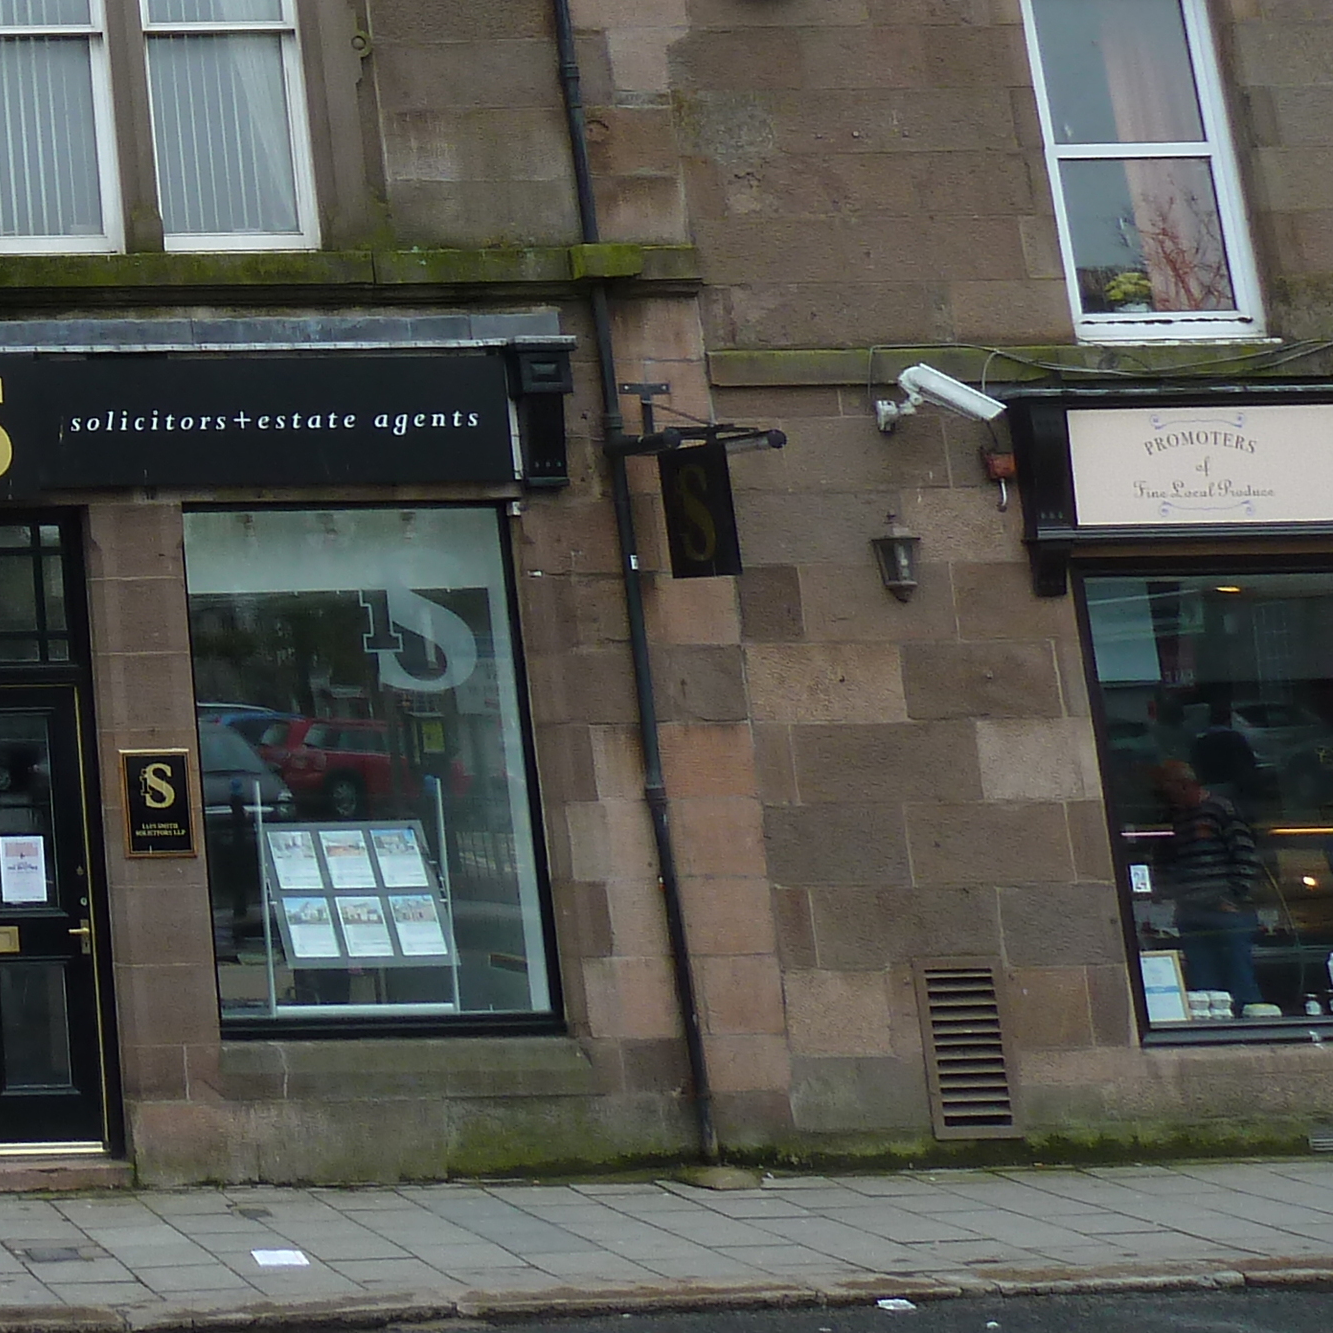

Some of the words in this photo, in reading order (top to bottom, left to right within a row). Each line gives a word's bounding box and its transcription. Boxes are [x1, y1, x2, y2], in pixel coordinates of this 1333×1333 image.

[374, 409, 480, 435] agents
[1144, 430, 1258, 456] PROMOTERS
[1195, 456, 1211, 477] of
[1133, 480, 1167, 499] Fine
[1170, 479, 1215, 498] Local
[1217, 478, 1275, 498] Produce
